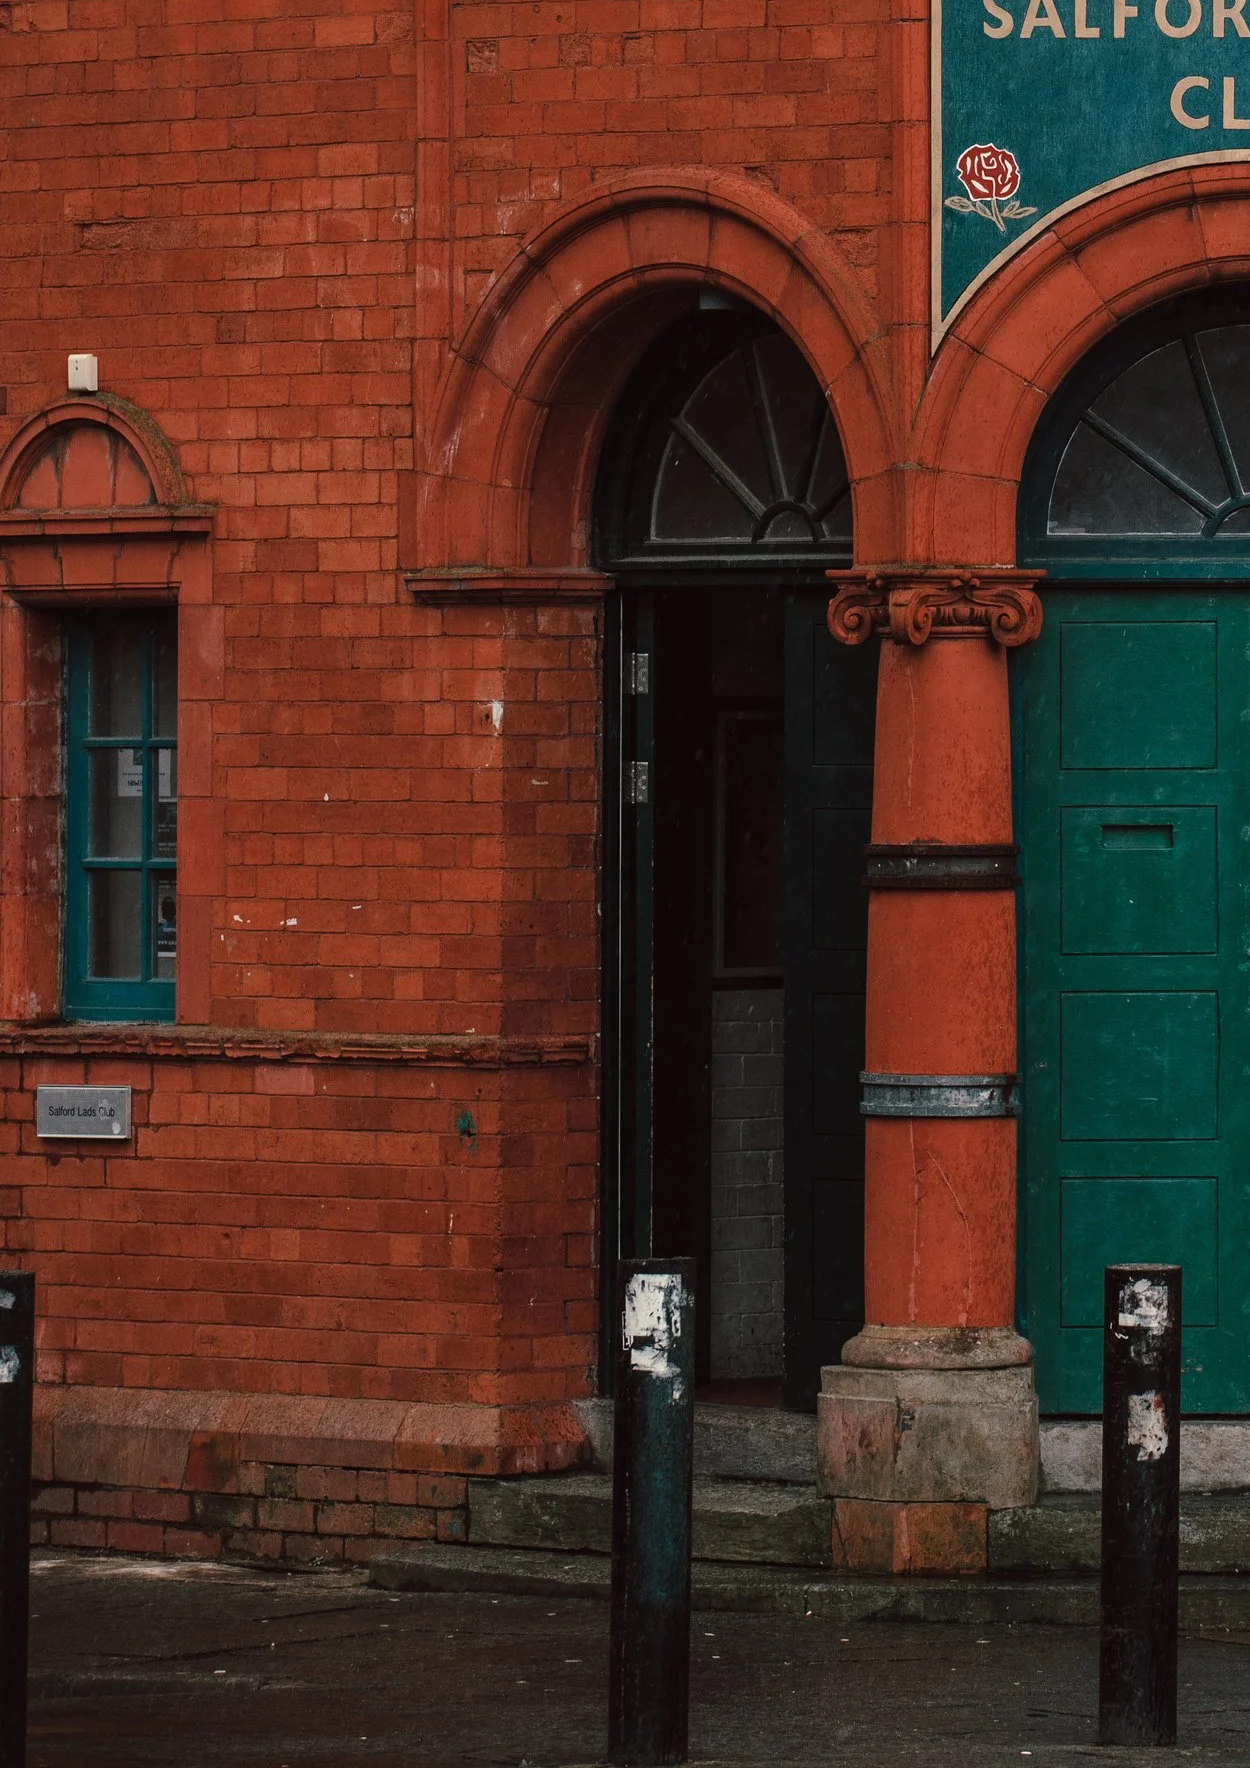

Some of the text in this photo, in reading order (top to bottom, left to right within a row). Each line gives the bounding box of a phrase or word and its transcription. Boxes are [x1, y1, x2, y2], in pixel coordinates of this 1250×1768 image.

[48, 1106, 115, 1118] Salford Lads Club
